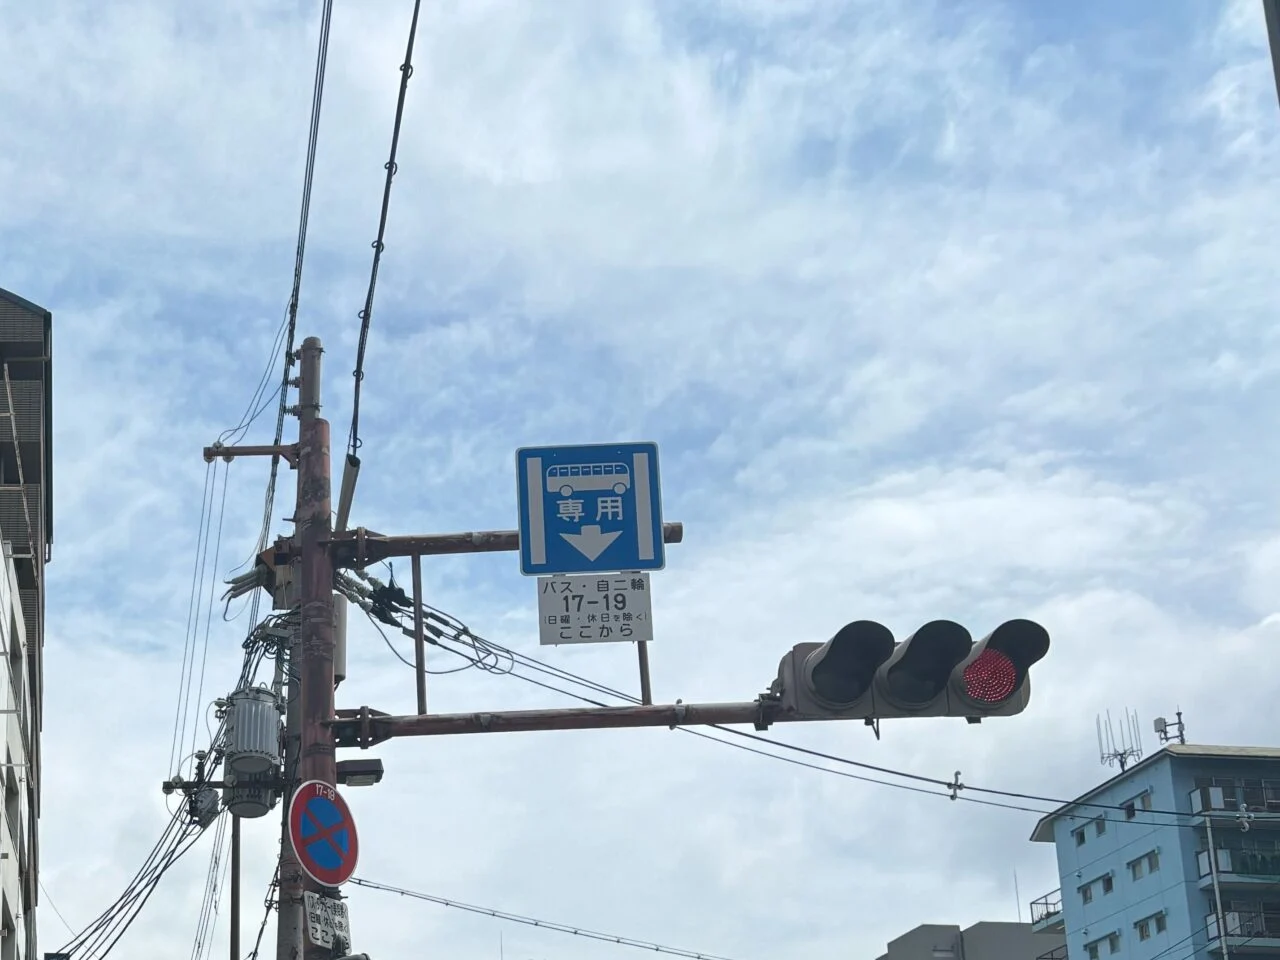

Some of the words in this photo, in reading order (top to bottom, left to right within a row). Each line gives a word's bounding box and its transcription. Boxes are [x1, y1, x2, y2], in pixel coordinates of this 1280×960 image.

[556, 496, 623, 522] 専用
[543, 578, 645, 594] バス・自二輪
[562, 593, 627, 613] 17-19
[559, 624, 633, 639] ここから
